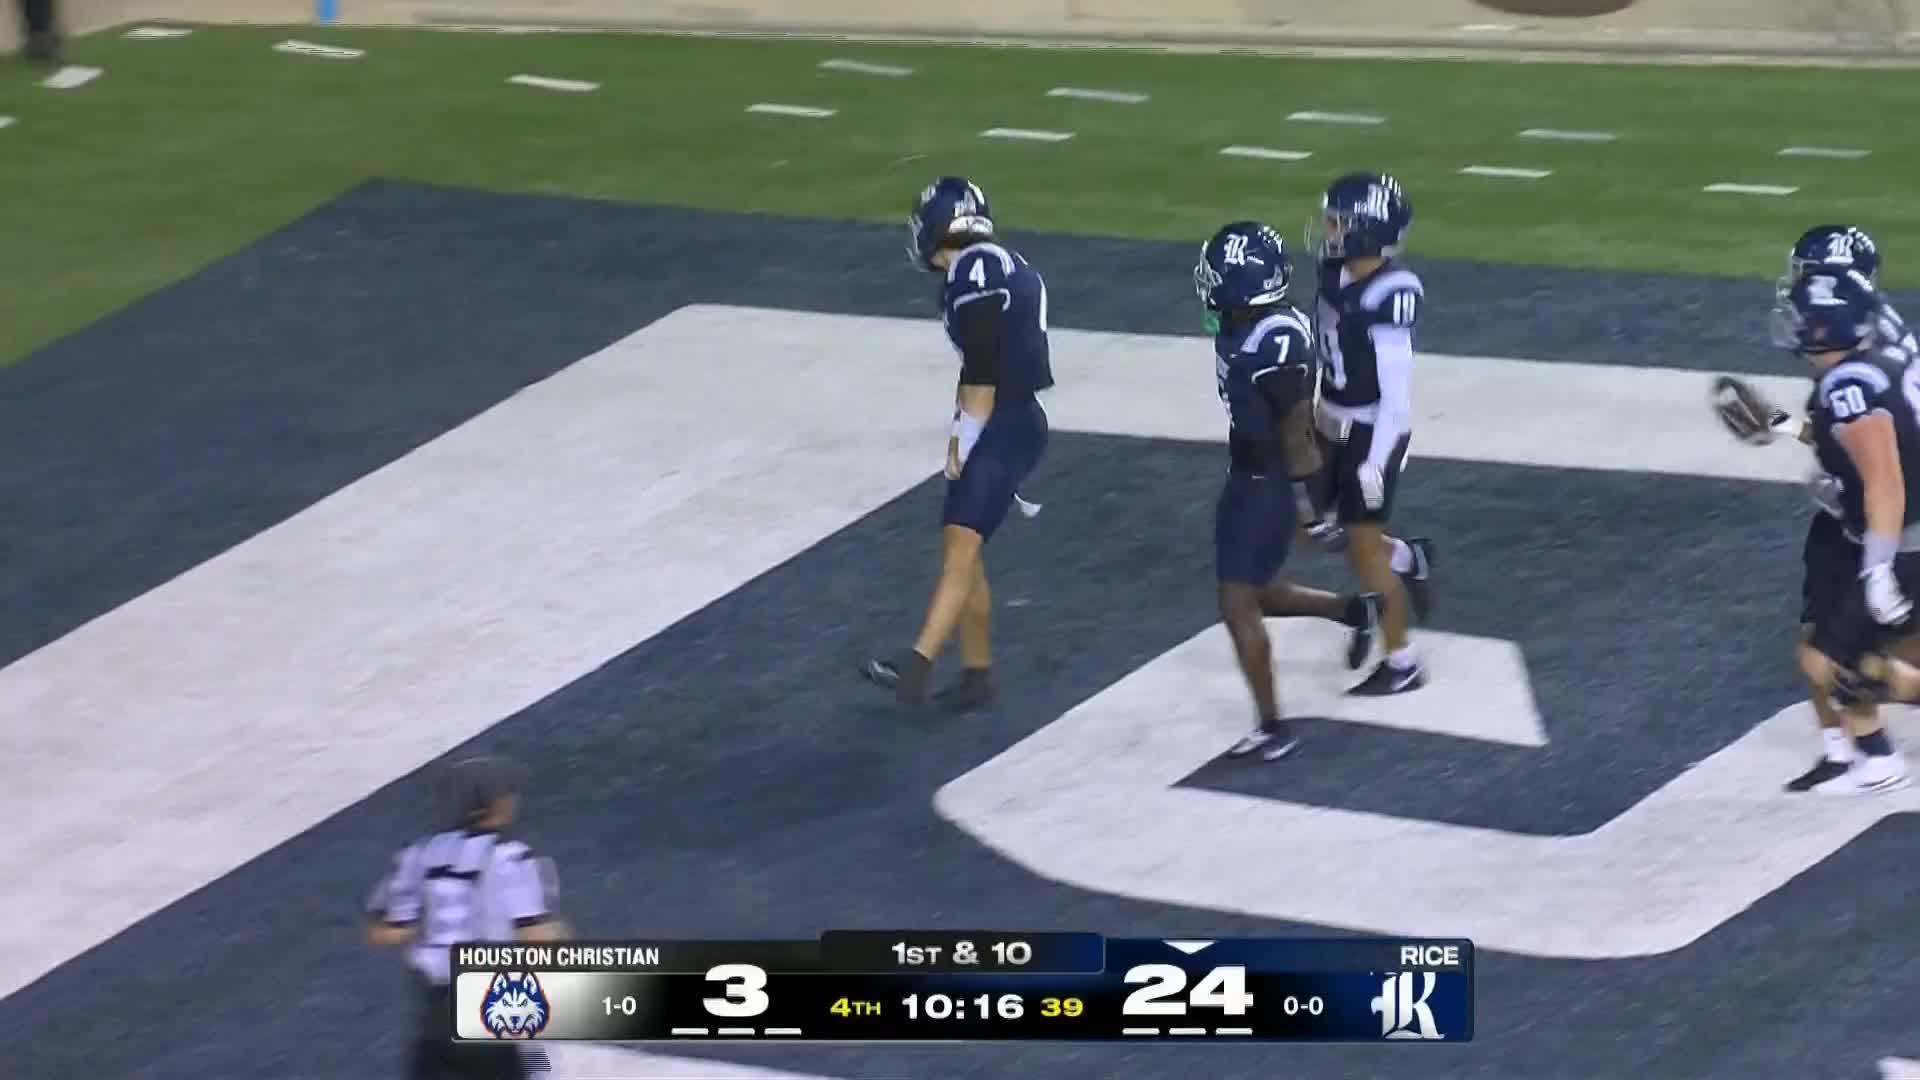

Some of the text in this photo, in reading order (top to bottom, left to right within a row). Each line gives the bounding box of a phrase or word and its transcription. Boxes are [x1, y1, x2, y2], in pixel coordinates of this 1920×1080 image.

[1223, 233, 1249, 265] R
[968, 256, 987, 288] 4
[1273, 335, 1290, 364] 7
